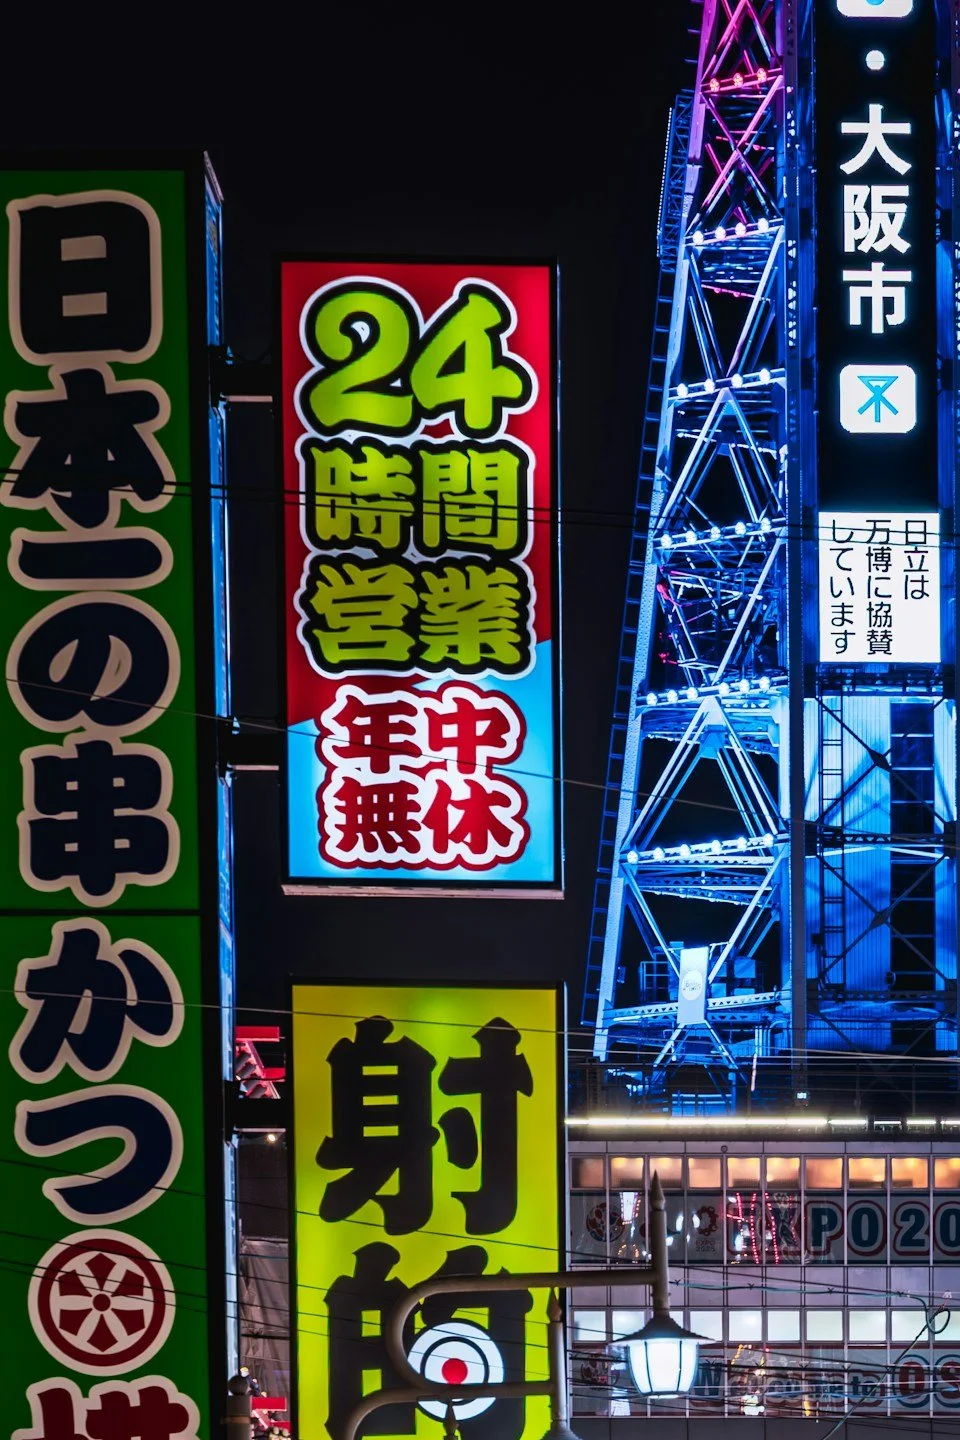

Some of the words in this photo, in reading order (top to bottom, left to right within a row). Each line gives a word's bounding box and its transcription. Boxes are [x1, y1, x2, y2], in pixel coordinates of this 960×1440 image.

[295, 277, 538, 438] 24
[297, 438, 537, 556] 時間
[902, 519, 929, 600] 日立は
[297, 554, 537, 680] 営業
[826, 519, 857, 655] しています
[865, 519, 893, 655] 万博に協賛
[4, 191, 184, 1226] 日本一の串かつ
[316, 683, 524, 774] 年中
[318, 772, 530, 868] 無休
